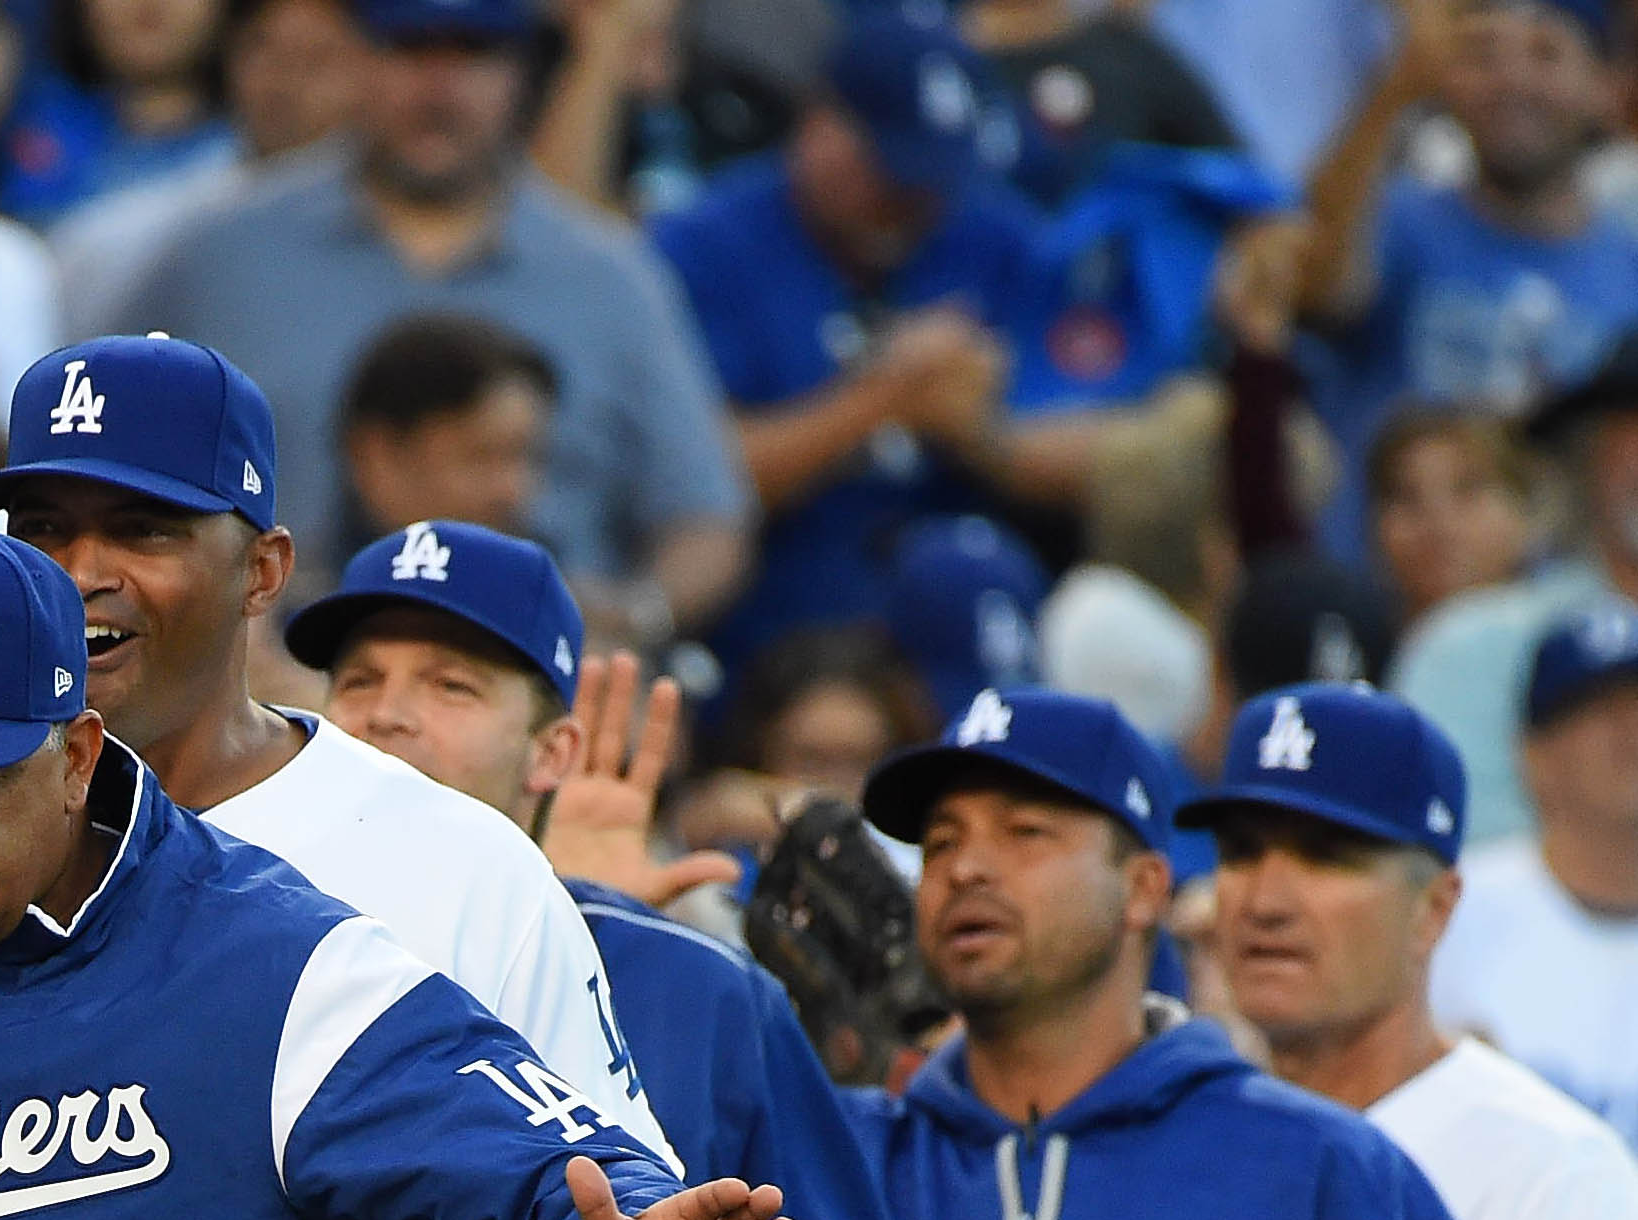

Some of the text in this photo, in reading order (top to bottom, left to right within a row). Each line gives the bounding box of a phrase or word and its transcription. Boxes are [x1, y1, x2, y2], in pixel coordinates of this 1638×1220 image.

[50, 360, 105, 434] LA
[392, 521, 451, 582] LA
[1258, 696, 1316, 771] LA
[455, 1059, 618, 1144] LA
